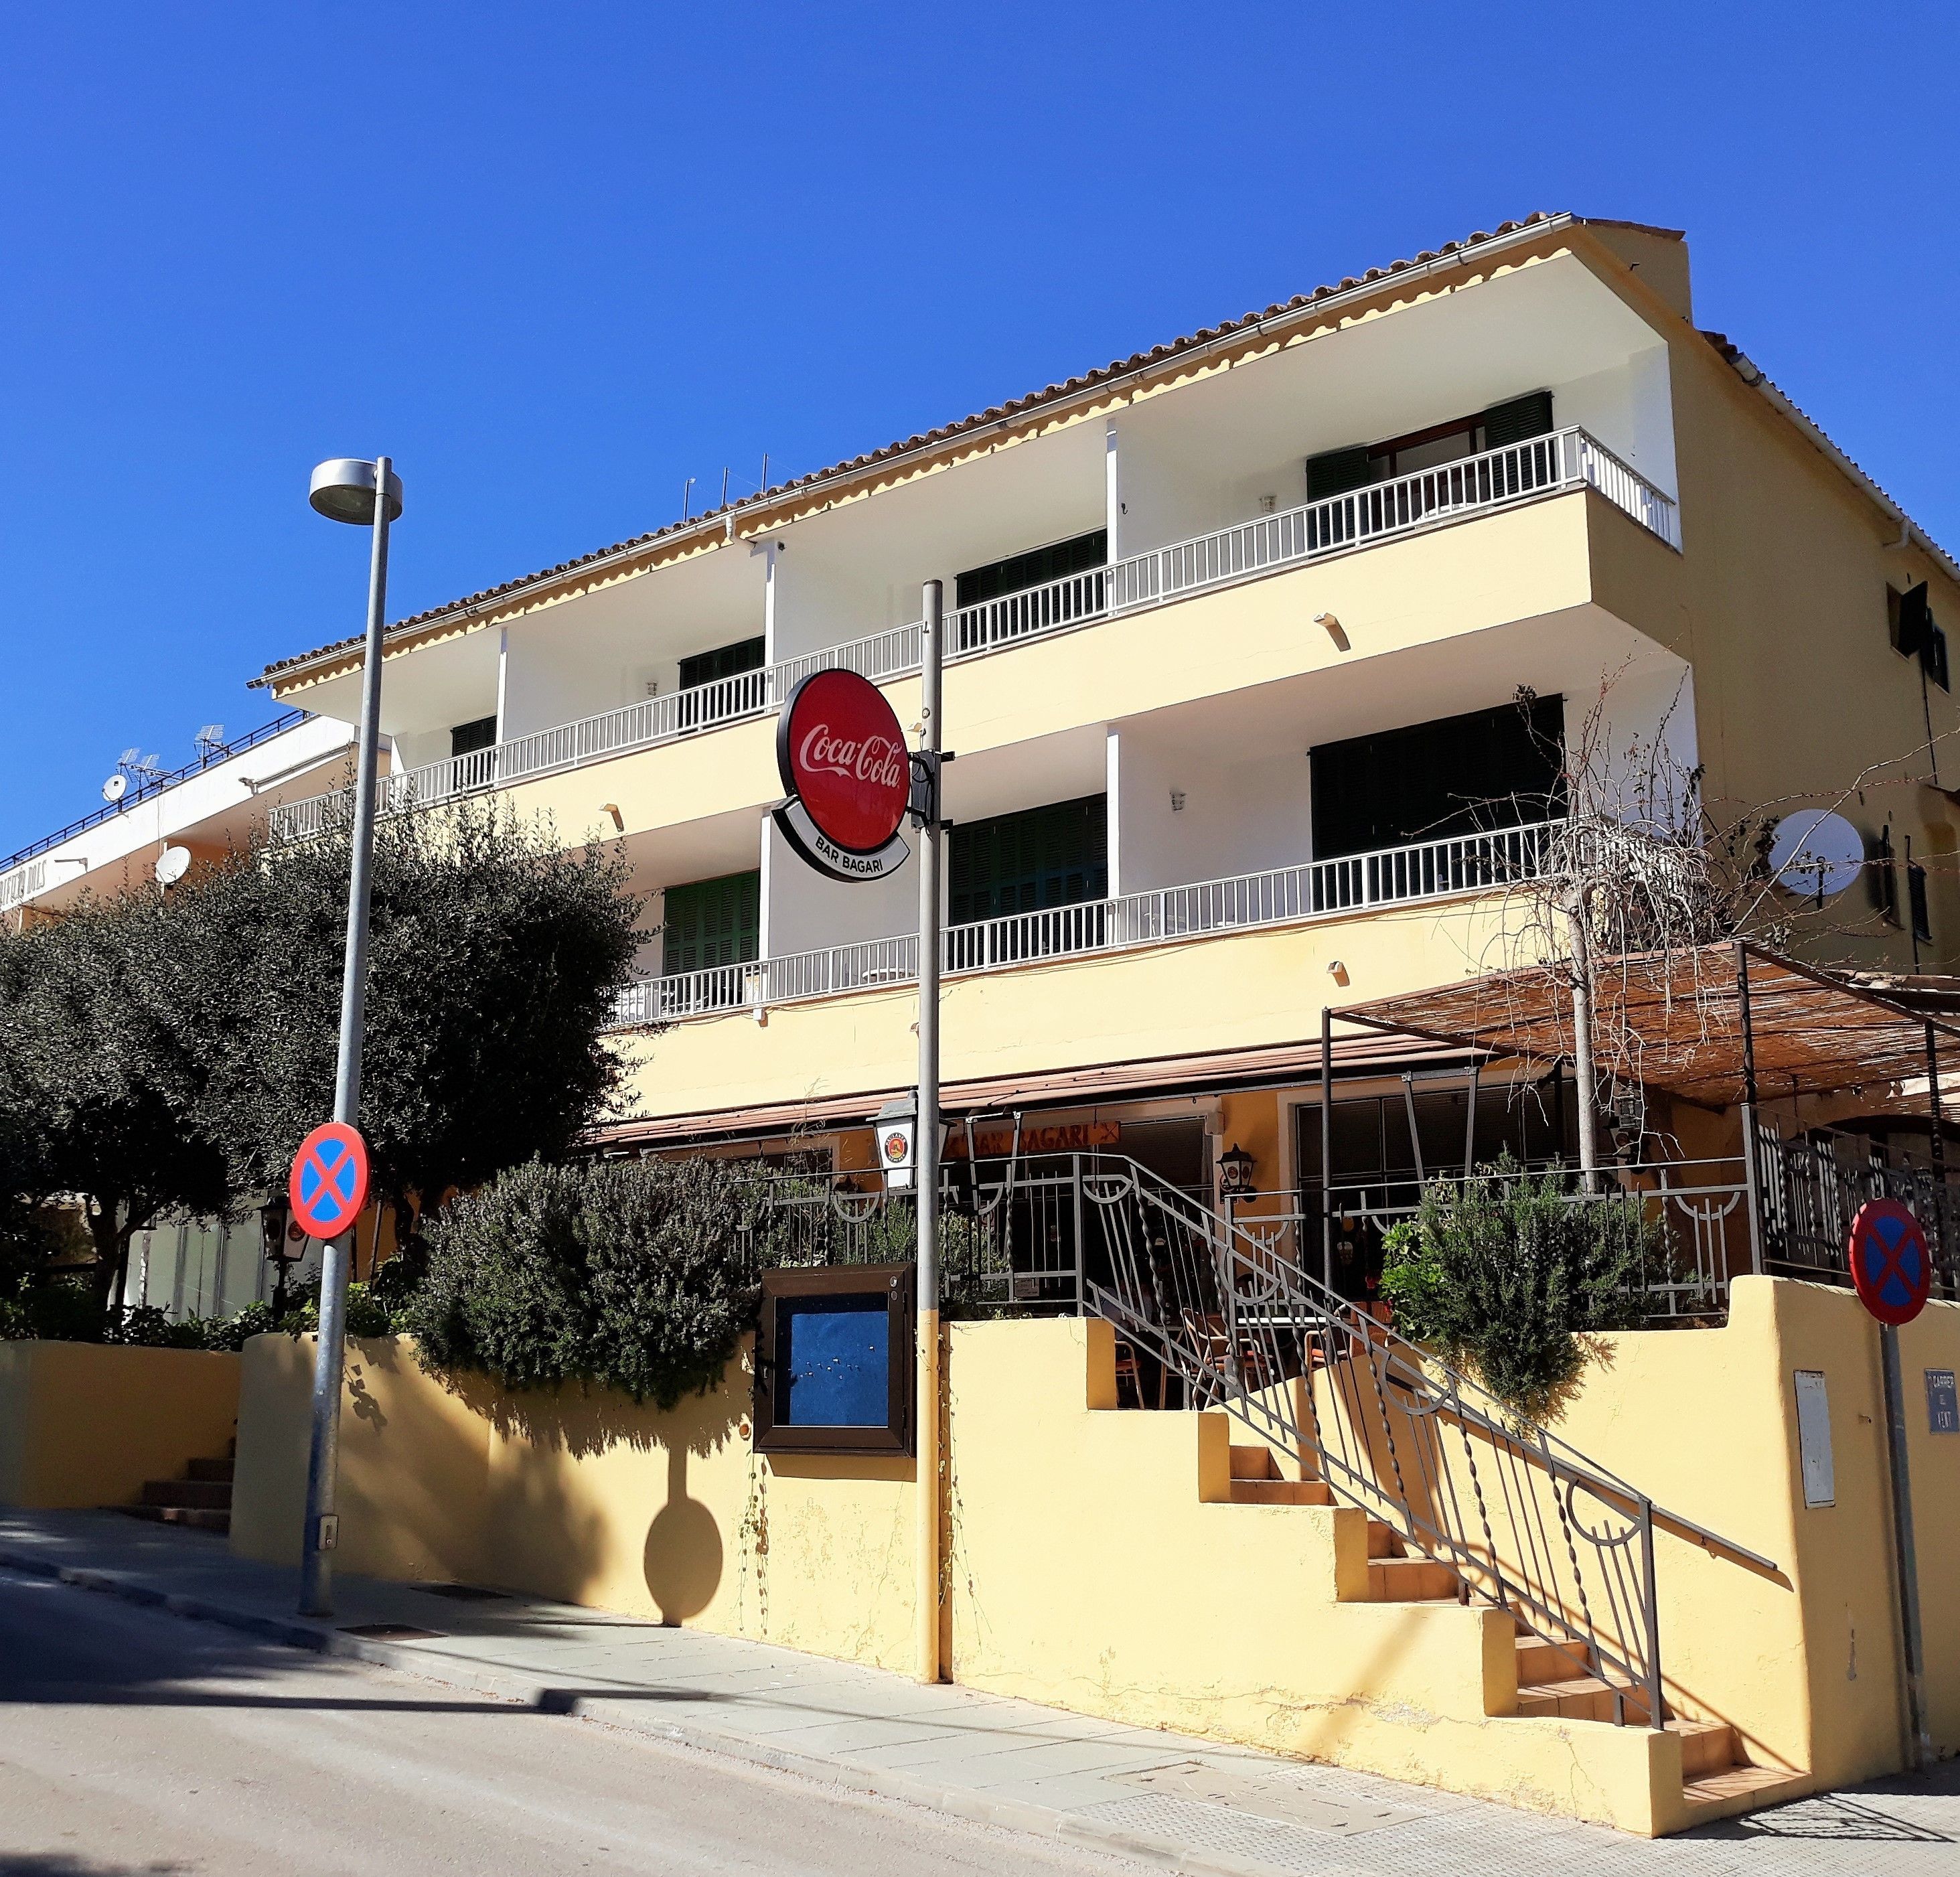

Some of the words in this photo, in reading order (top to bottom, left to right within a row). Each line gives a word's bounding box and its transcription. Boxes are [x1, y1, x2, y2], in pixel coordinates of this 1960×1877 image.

[800, 724, 903, 788] Coca-Cola
[815, 835, 840, 864] BAR
[842, 854, 884, 873] BAGARI
